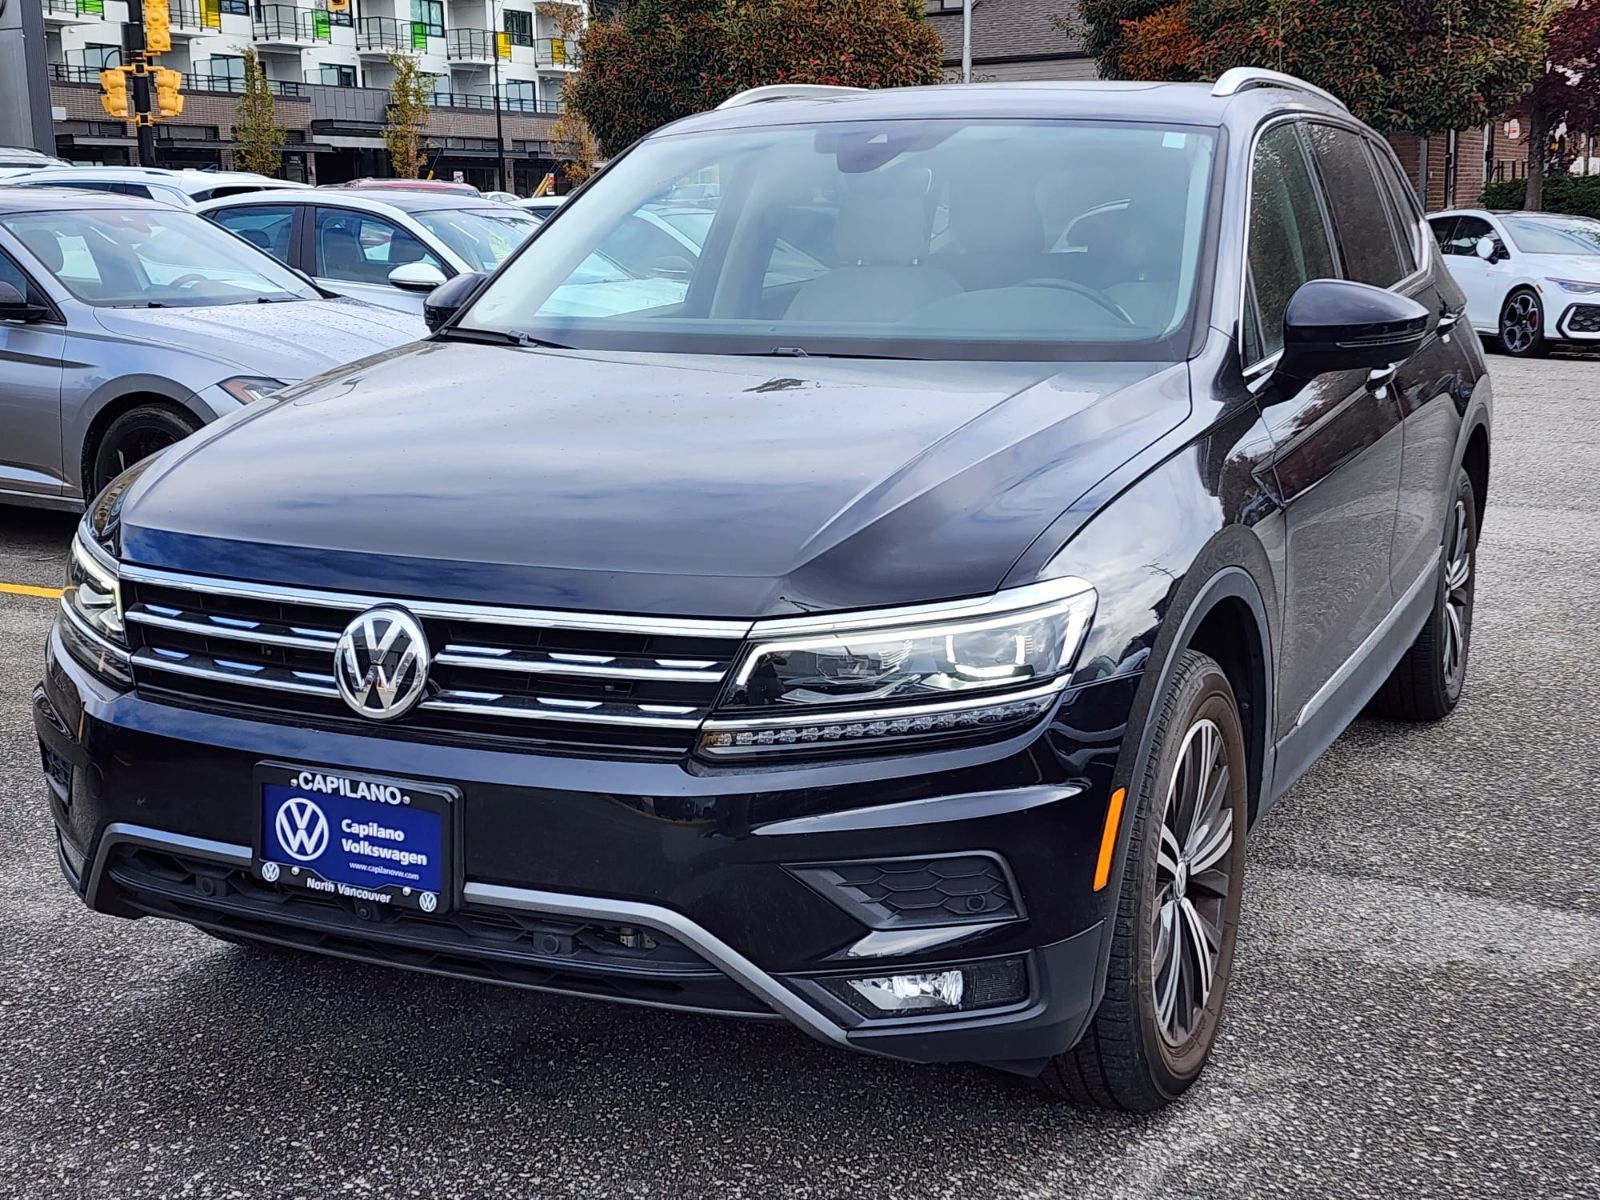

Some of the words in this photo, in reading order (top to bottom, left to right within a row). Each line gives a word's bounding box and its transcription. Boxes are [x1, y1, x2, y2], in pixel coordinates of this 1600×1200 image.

[299, 771, 402, 805] CAPILANO
[341, 818, 405, 842] Capilano
[341, 838, 428, 866] Volkswagen
[348, 862, 420, 881] www.capilanovw.com
[306, 877, 335, 893] North
[337, 883, 392, 904] Vancouver
